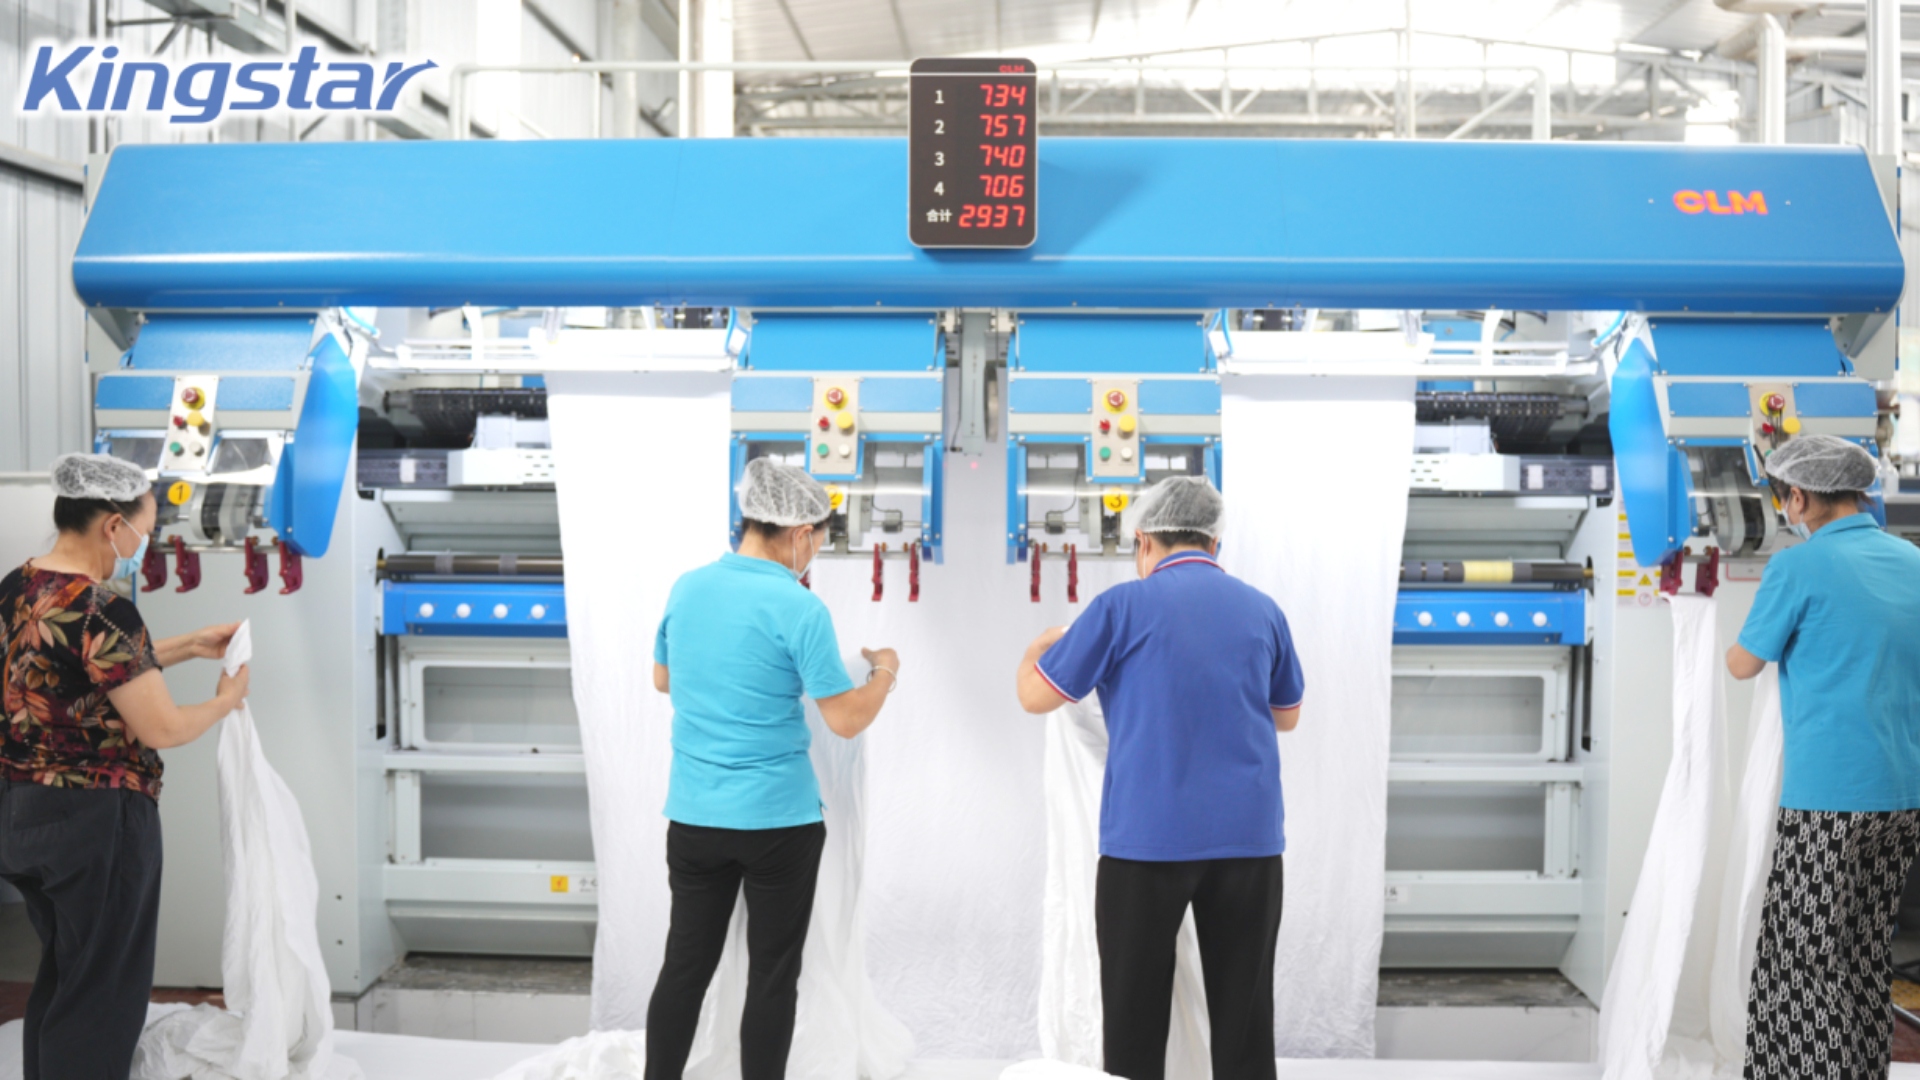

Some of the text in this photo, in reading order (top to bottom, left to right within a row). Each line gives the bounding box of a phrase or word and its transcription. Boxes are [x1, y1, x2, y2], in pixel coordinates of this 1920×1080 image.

[935, 84, 1026, 107] 1 734
[934, 114, 1026, 137] 2 757
[934, 145, 1026, 168] 3 740
[934, 175, 1025, 198] 4 706
[1673, 189, 1768, 215] CLM
[926, 204, 1026, 228] 合计 2937
[176, 484, 184, 501] 1
[1110, 493, 1122, 508] 3
